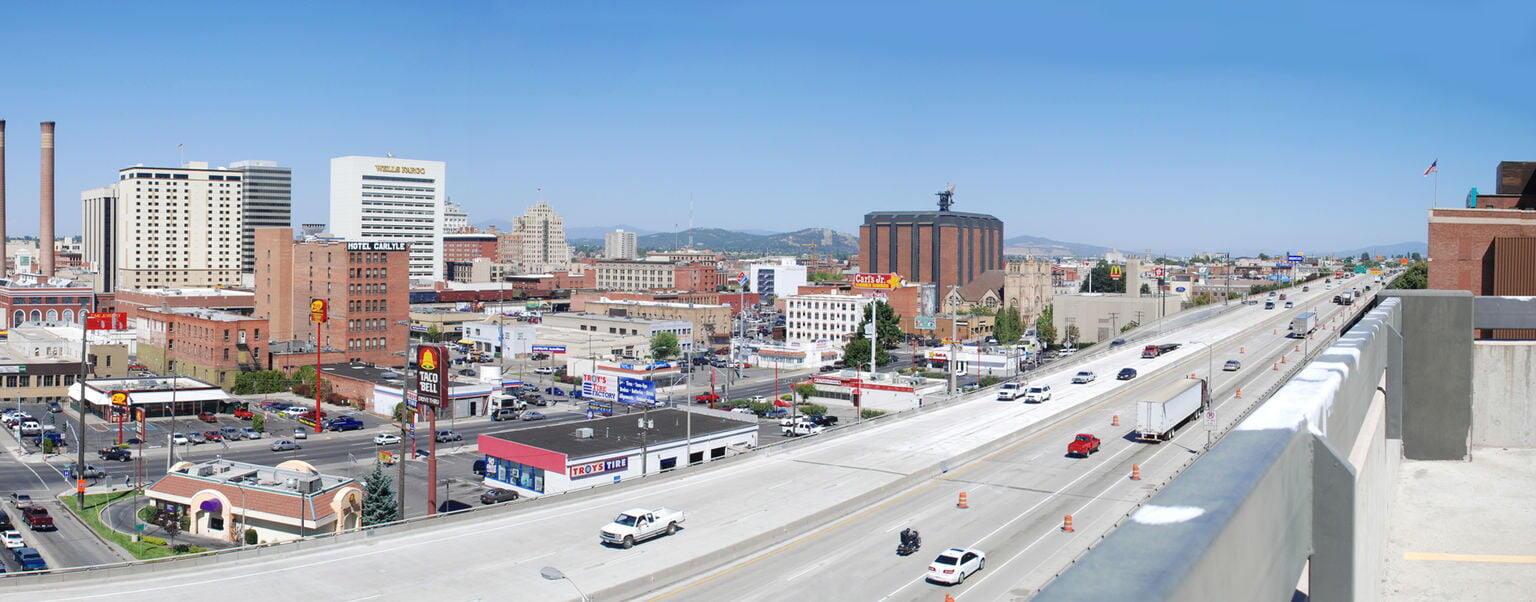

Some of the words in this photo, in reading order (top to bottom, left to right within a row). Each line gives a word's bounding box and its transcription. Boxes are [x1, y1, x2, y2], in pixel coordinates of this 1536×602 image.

[374, 165, 401, 173] WELLS
[401, 167, 426, 175] FARGO
[348, 242, 371, 250] HOTEL
[373, 242, 406, 250] CARLYLE
[855, 274, 876, 284] Carl's
[419, 371, 439, 383] TACO
[583, 374, 607, 384] TROY'S
[420, 382, 438, 393] BELL
[592, 384, 607, 392] TIRE
[592, 391, 616, 400] FACTORY
[573, 463, 604, 475] TROYS
[606, 458, 627, 470] TIRE
